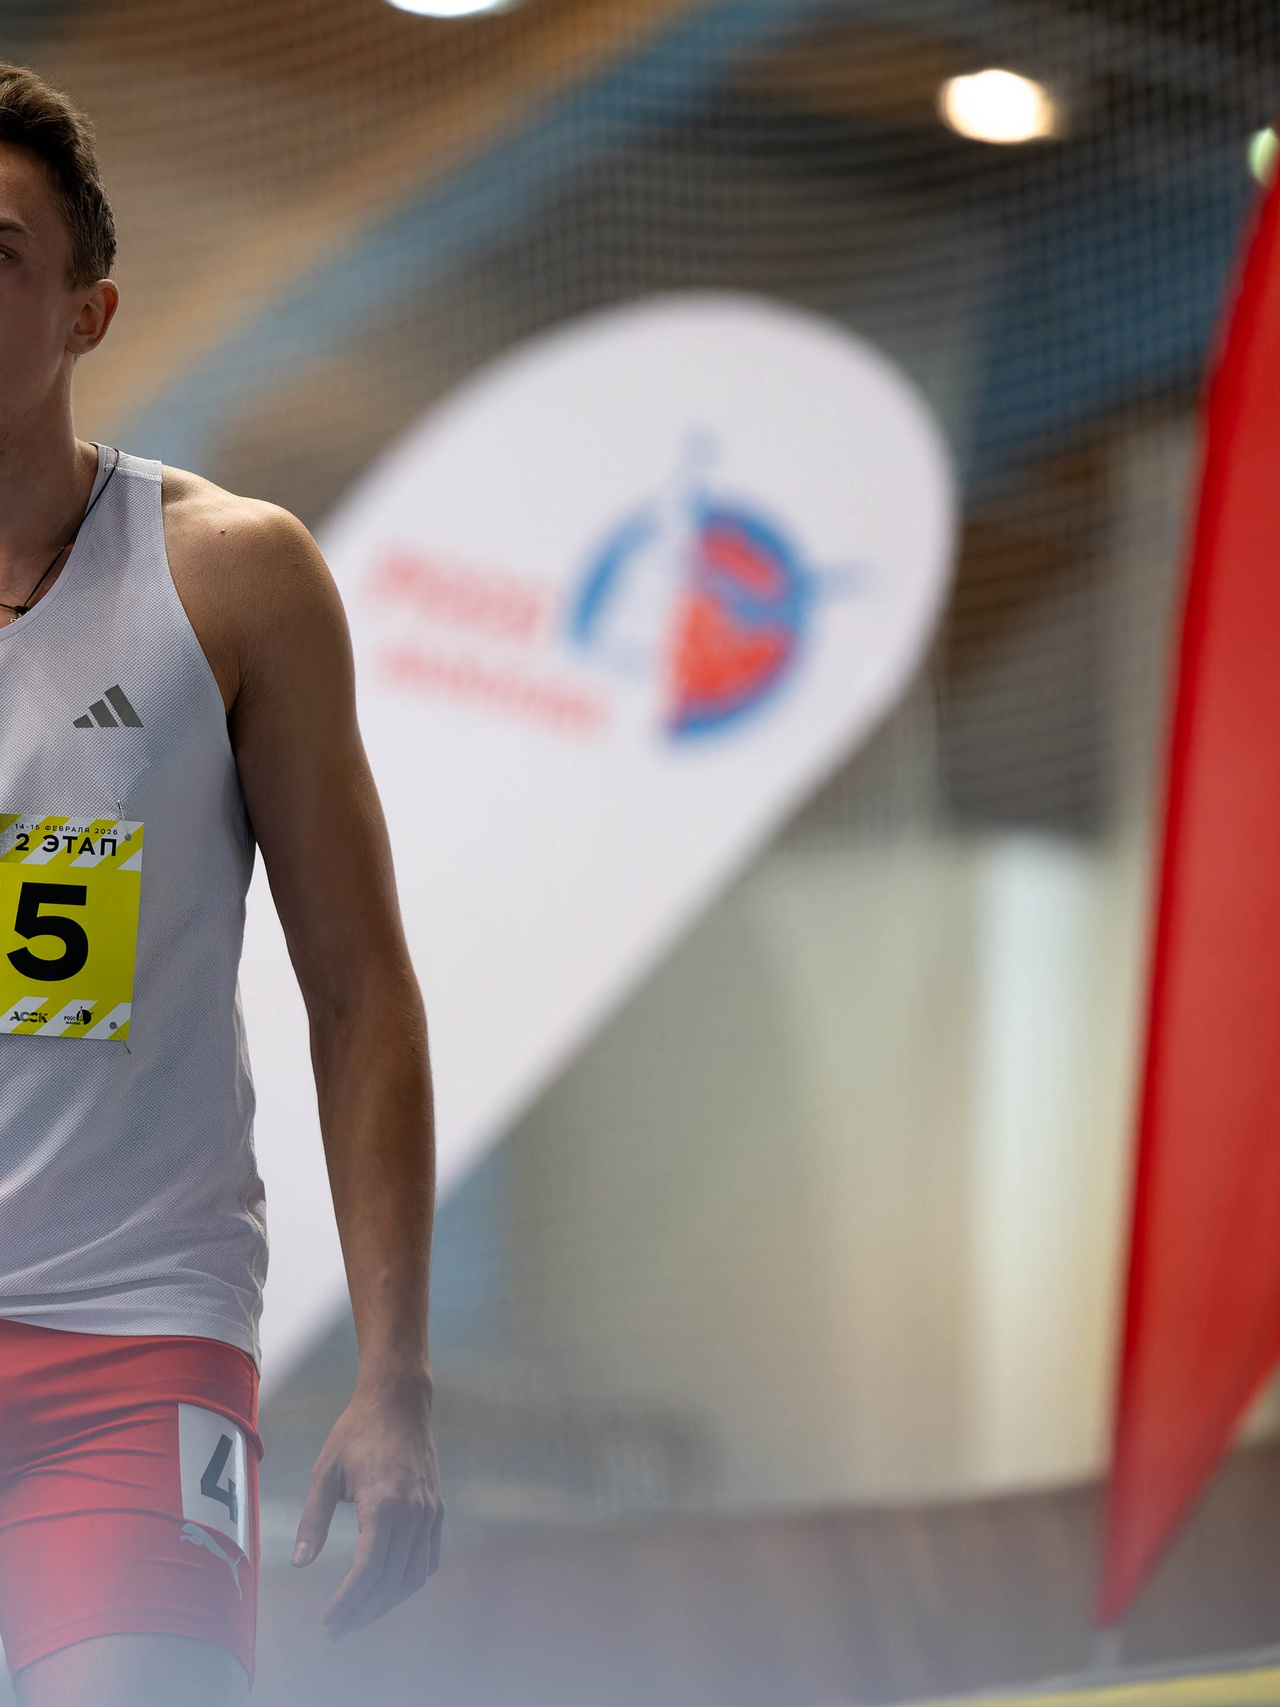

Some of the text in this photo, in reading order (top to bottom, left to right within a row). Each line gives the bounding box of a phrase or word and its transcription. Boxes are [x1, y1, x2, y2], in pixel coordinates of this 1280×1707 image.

[15, 823, 118, 836] 14-15 ФЕВРАЛЯ 2026
[15, 833, 117, 857] 2 ЭТАП
[200, 1433, 238, 1524] 4
